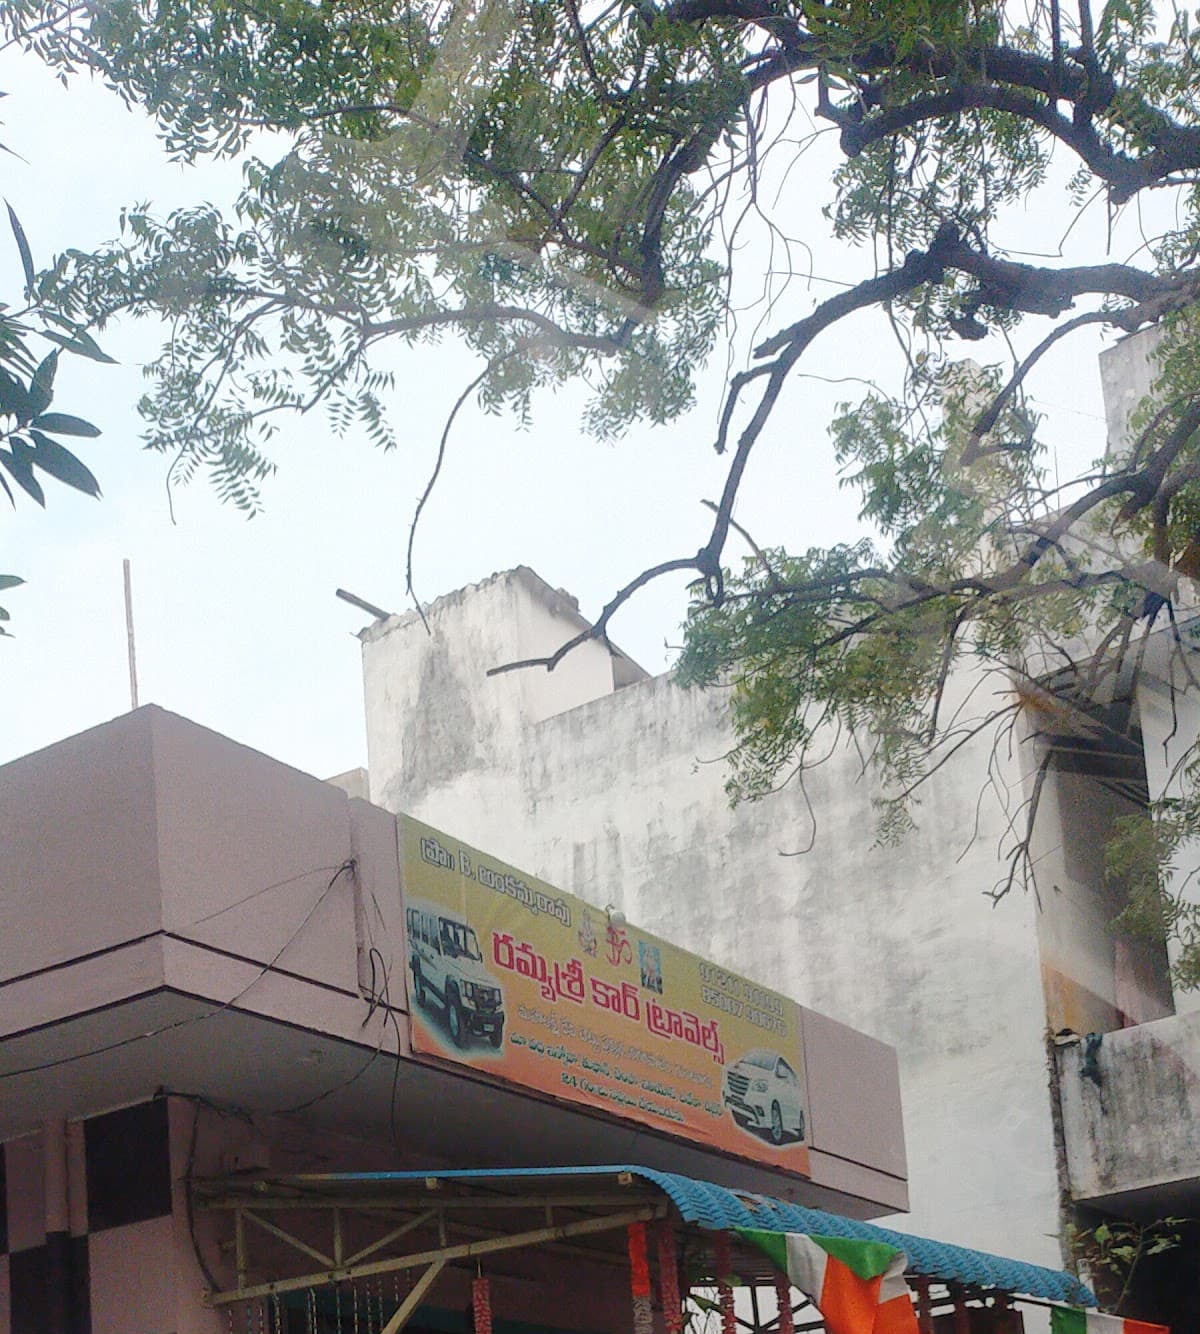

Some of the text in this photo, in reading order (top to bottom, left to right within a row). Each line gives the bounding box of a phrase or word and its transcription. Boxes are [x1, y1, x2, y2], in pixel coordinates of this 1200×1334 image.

[492, 931, 725, 1065] రమ్యశ్రీ కార్ ట్రావెల్స్
